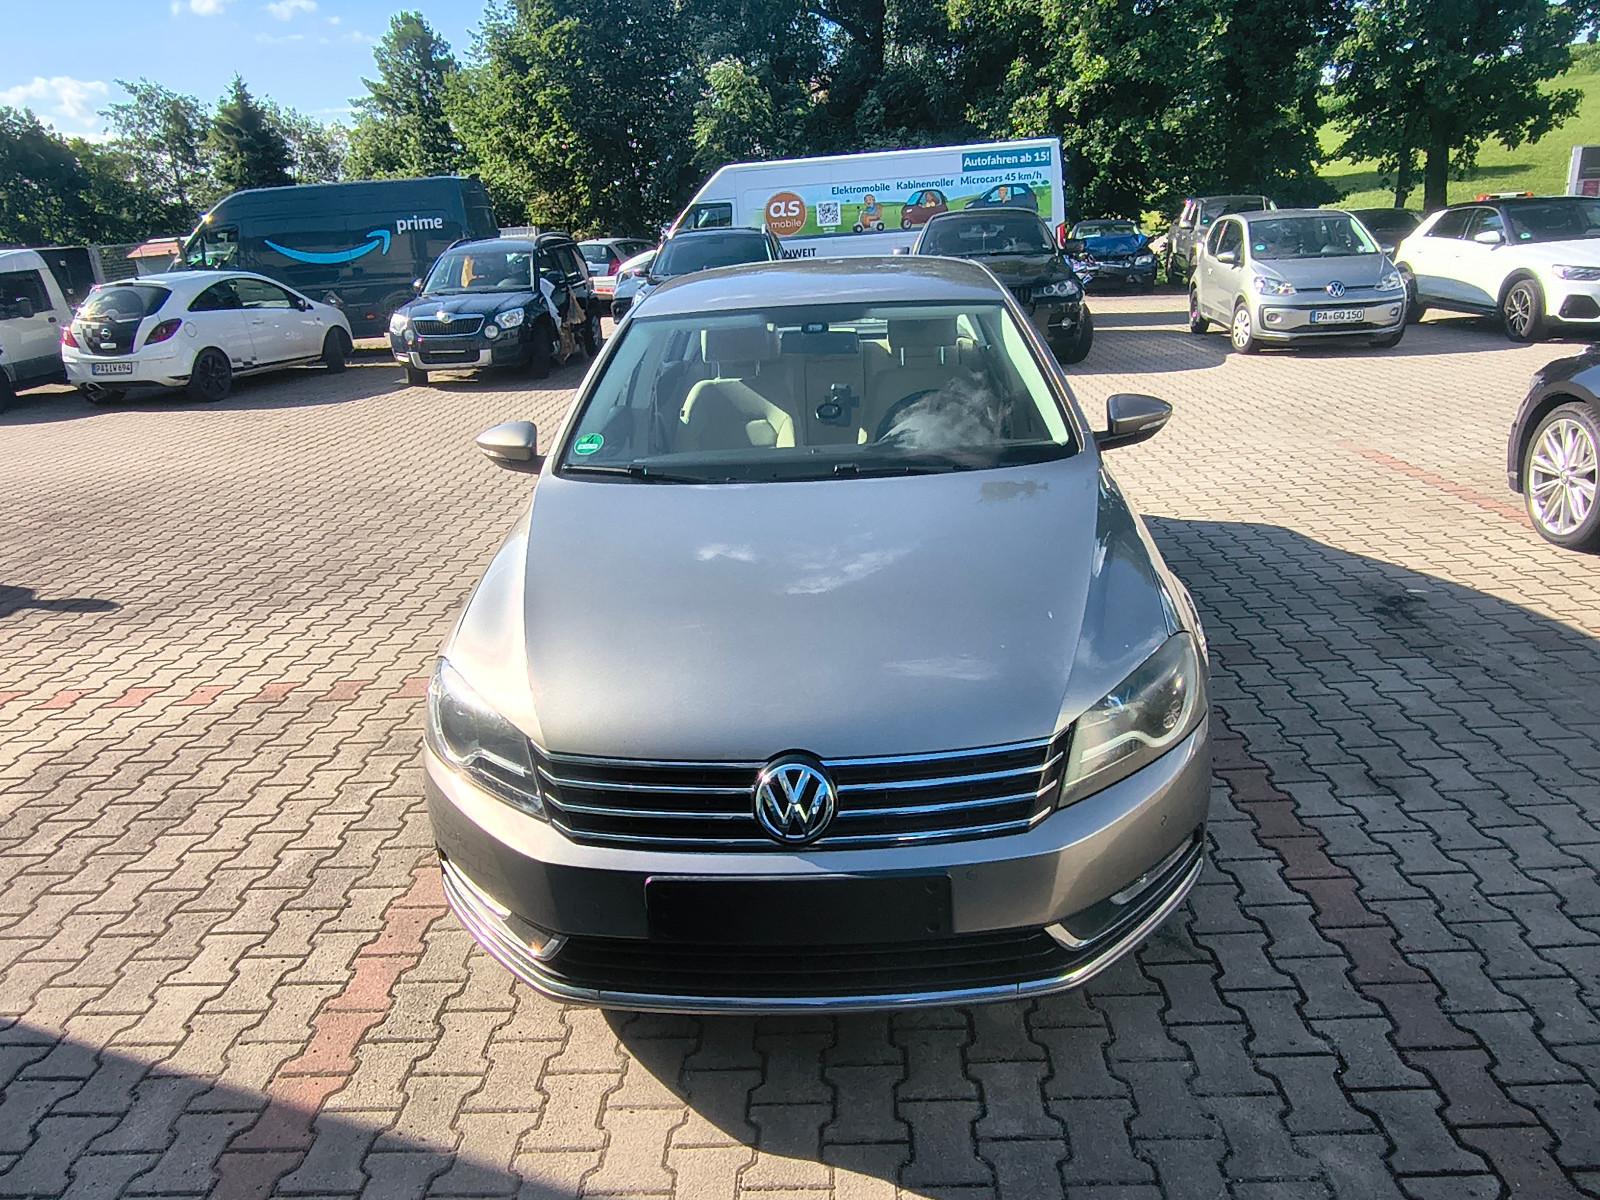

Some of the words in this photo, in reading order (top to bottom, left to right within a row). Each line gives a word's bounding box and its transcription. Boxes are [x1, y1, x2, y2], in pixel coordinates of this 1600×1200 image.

[963, 153, 1018, 167] Autofahren
[1020, 153, 1032, 164] ab
[1034, 151, 1051, 162] 15!
[831, 183, 890, 195] Elektromobile
[896, 178, 954, 190] Kabinenroller
[960, 174, 1003, 186] Microcars
[1004, 173, 1016, 182] 45
[1018, 170, 1042, 181] km/h
[769, 200, 800, 217] as
[396, 215, 443, 235] prime
[771, 219, 802, 229] mobile
[784, 248, 816, 258] NWEIT
